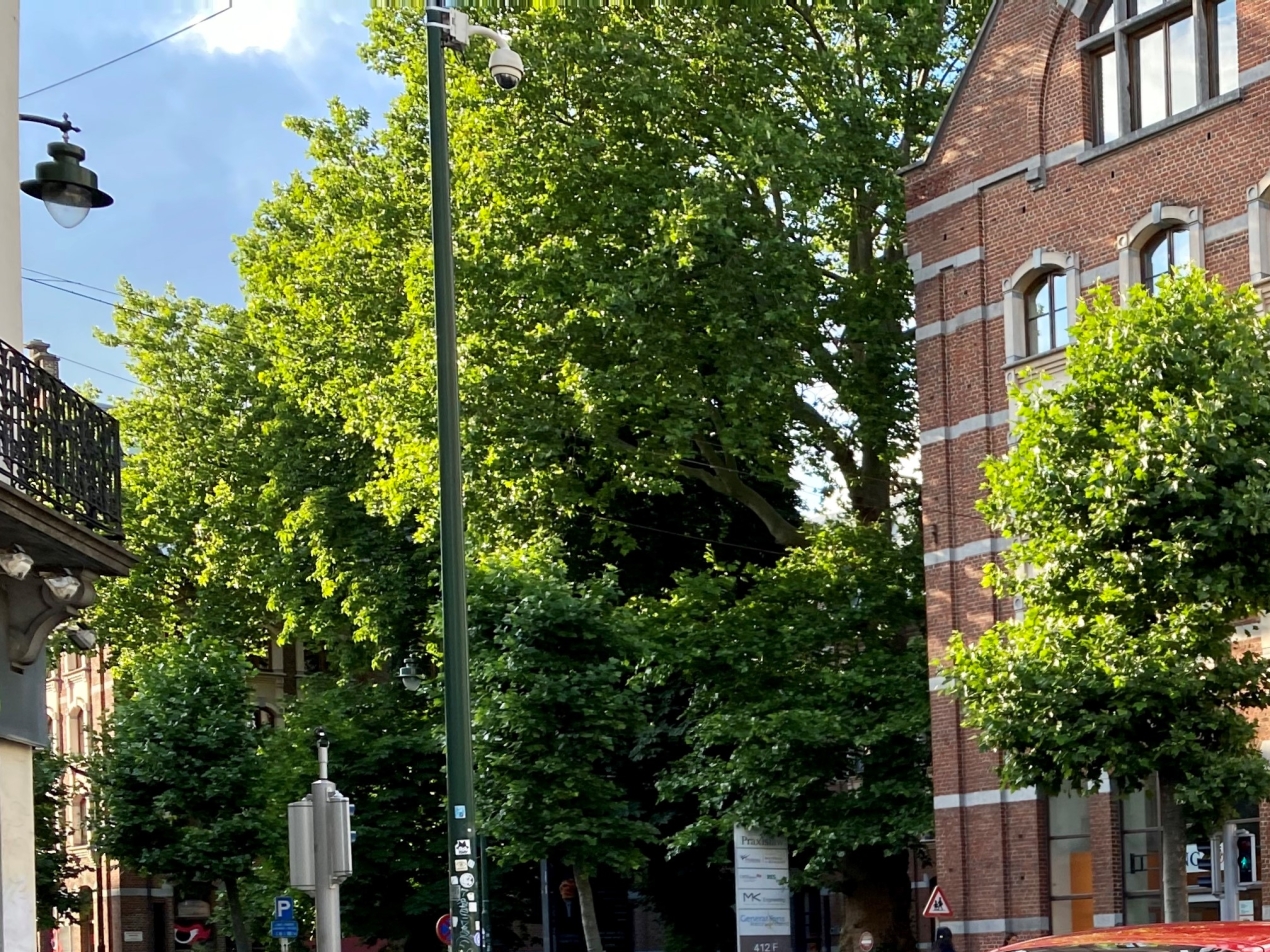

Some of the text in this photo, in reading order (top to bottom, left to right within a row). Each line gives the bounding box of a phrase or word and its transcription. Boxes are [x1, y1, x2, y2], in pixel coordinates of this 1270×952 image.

[277, 900, 291, 917] P
[753, 943, 778, 952] 412 F
